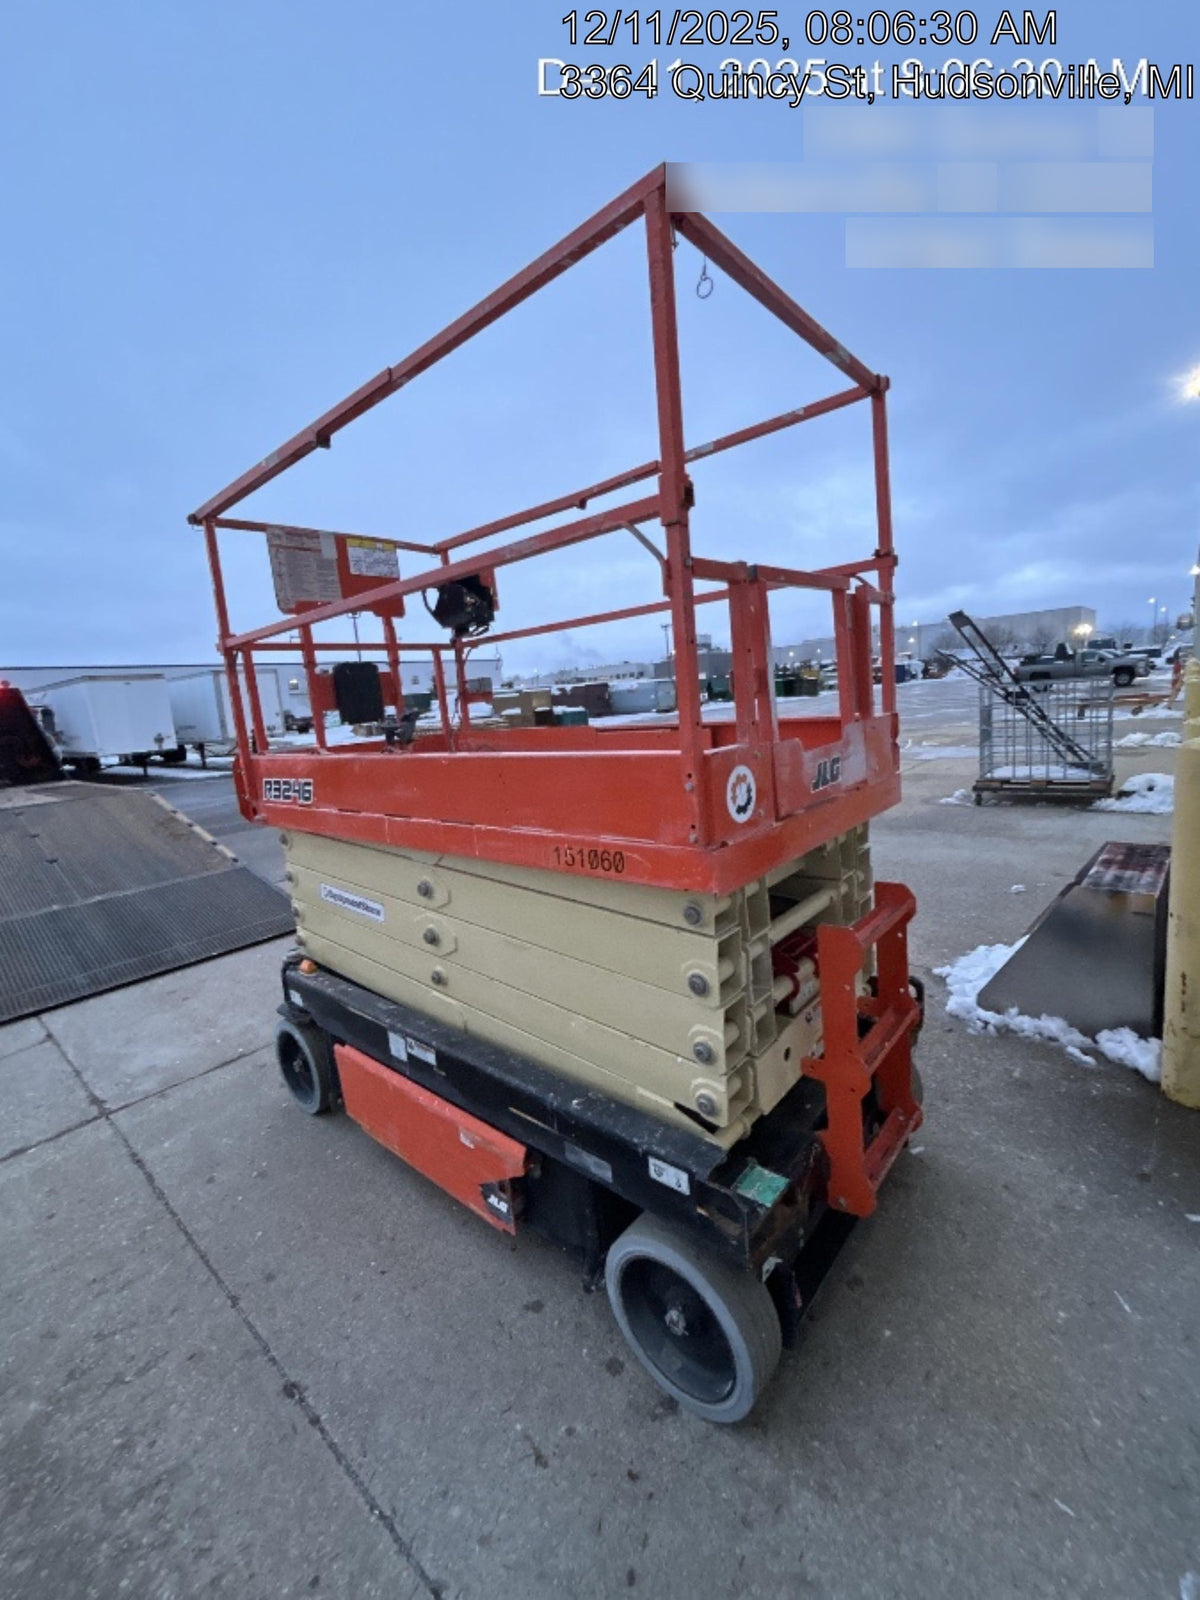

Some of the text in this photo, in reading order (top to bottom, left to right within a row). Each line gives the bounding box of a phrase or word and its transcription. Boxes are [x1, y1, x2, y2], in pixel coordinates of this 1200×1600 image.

[811, 755, 841, 792] JLG
[262, 778, 313, 804] R3246
[553, 846, 625, 874] 151060
